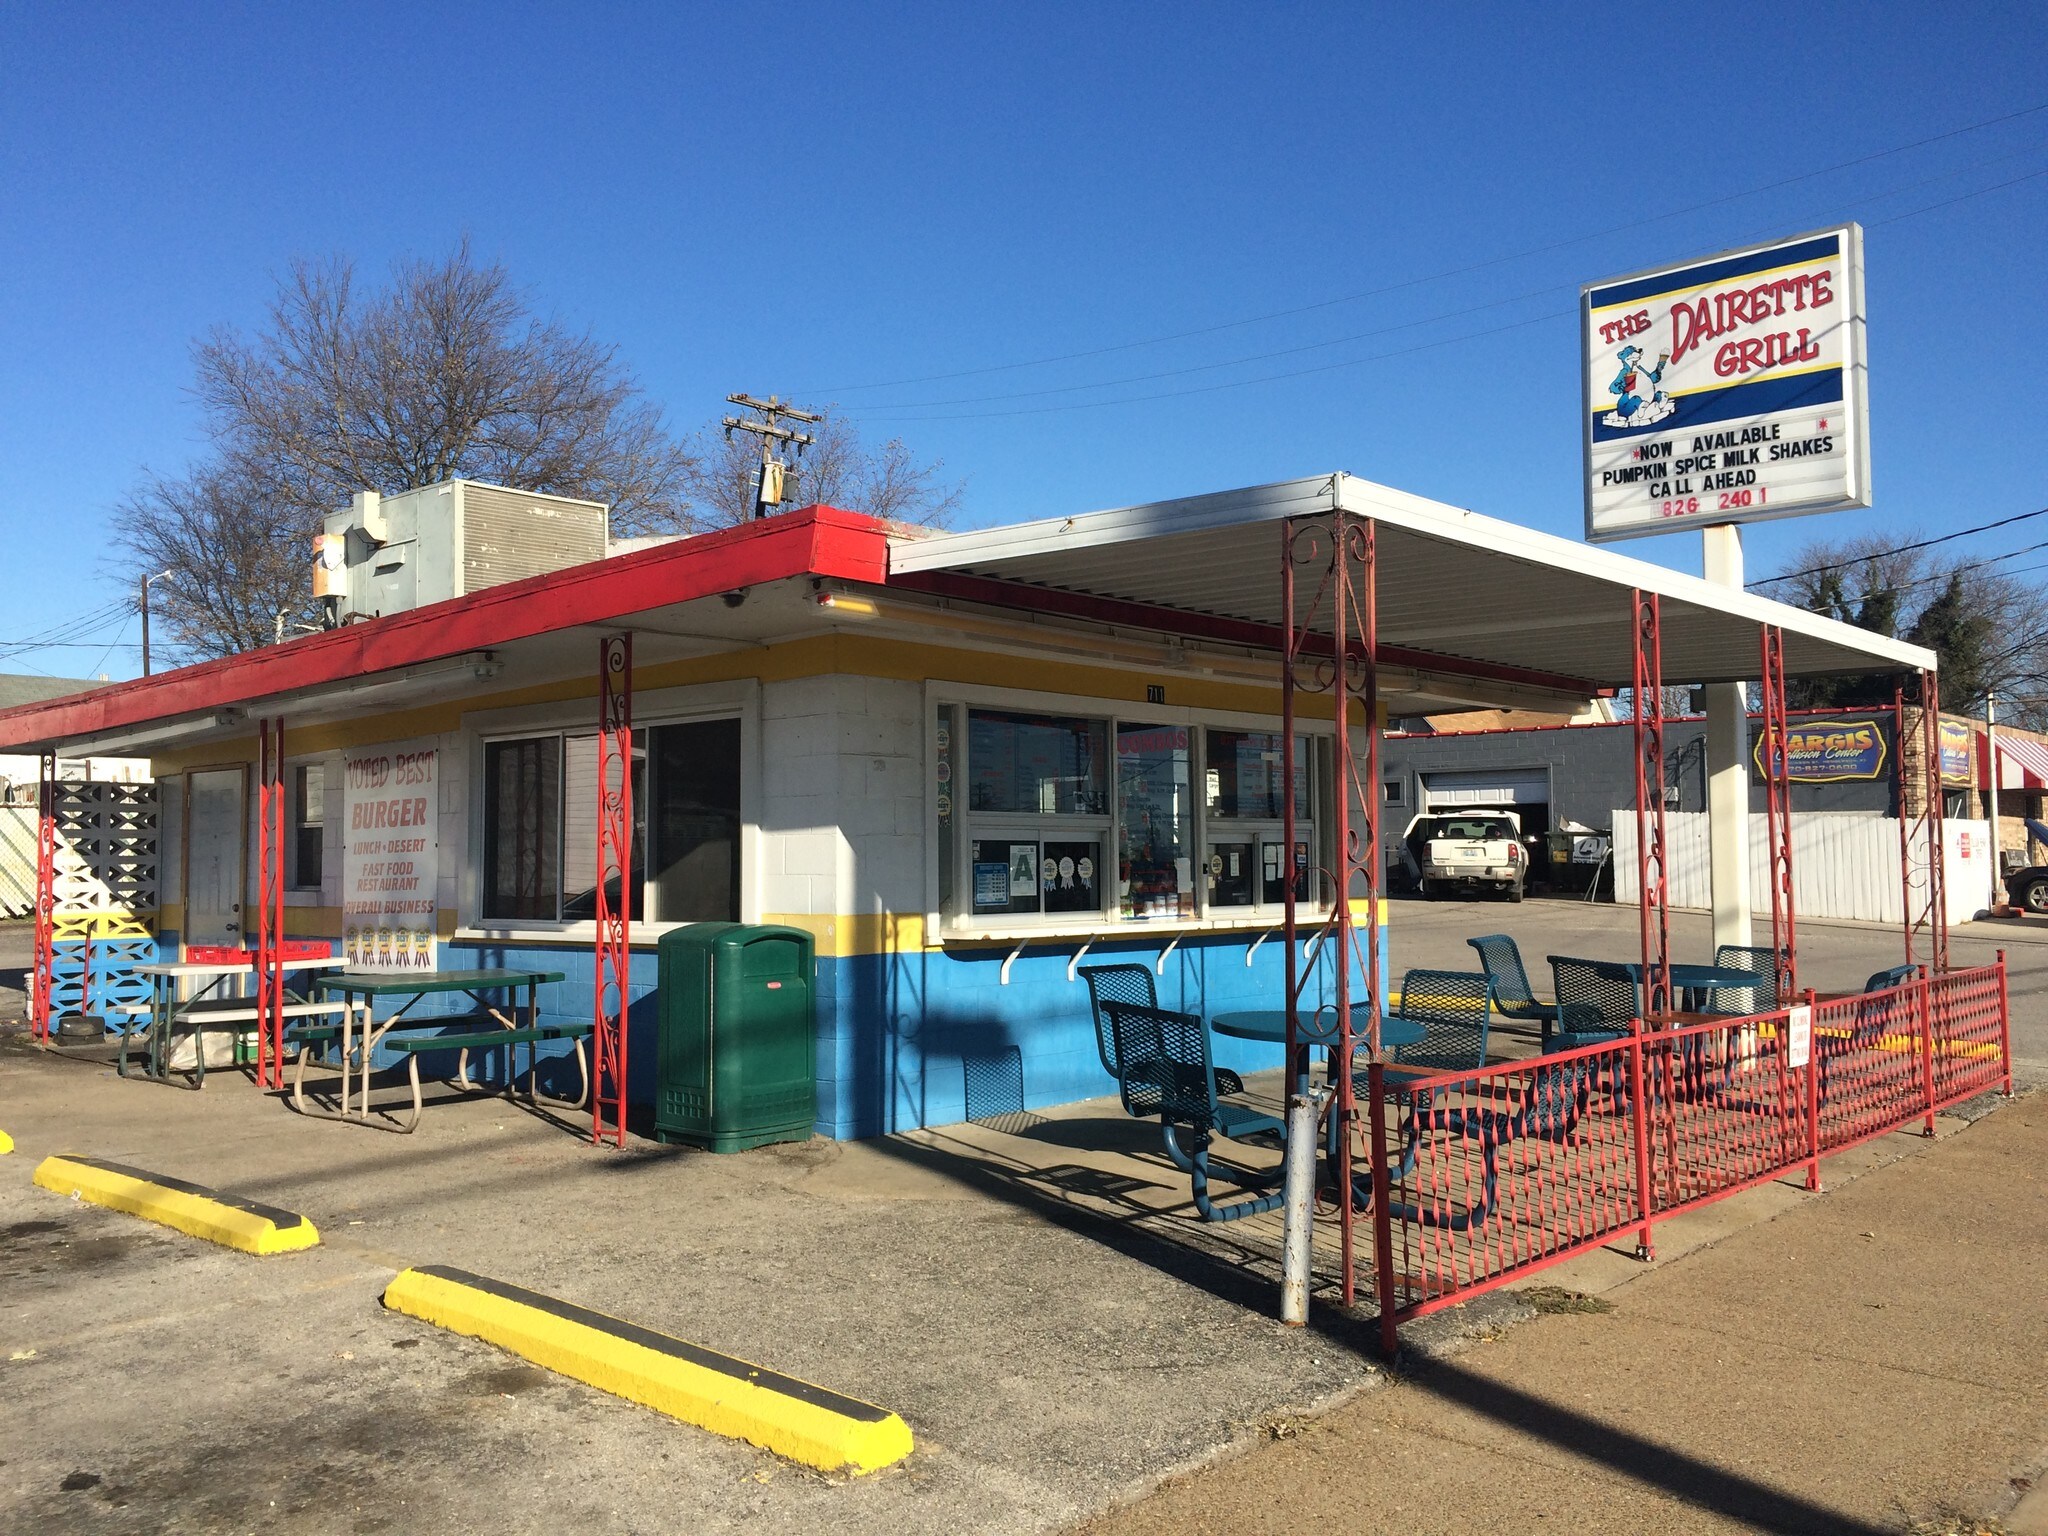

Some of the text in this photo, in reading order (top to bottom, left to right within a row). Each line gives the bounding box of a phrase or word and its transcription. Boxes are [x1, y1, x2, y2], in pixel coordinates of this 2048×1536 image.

[1599, 270, 1834, 365] THE DAIRETTE
[1713, 327, 1820, 377] GRILL
[1639, 423, 1781, 461] NOW AVAILABLE
[1602, 436, 1833, 486] PUMPKIN SPICE MILK SHAKES
[1650, 468, 1757, 499] CALL AHEAD
[1662, 496, 1698, 517] 826
[1148, 686, 1164, 702] 711
[1825, 745, 1864, 759] Center
[347, 750, 434, 790] VOTED BEST
[351, 797, 427, 830] BURGER
[353, 839, 426, 856] LUNCH DESERT
[362, 861, 414, 876] FAST FOOD
[1013, 854, 1034, 881] A
[357, 877, 419, 892] RESTAURANT
[345, 900, 434, 915] OVERALL BUSINESS
